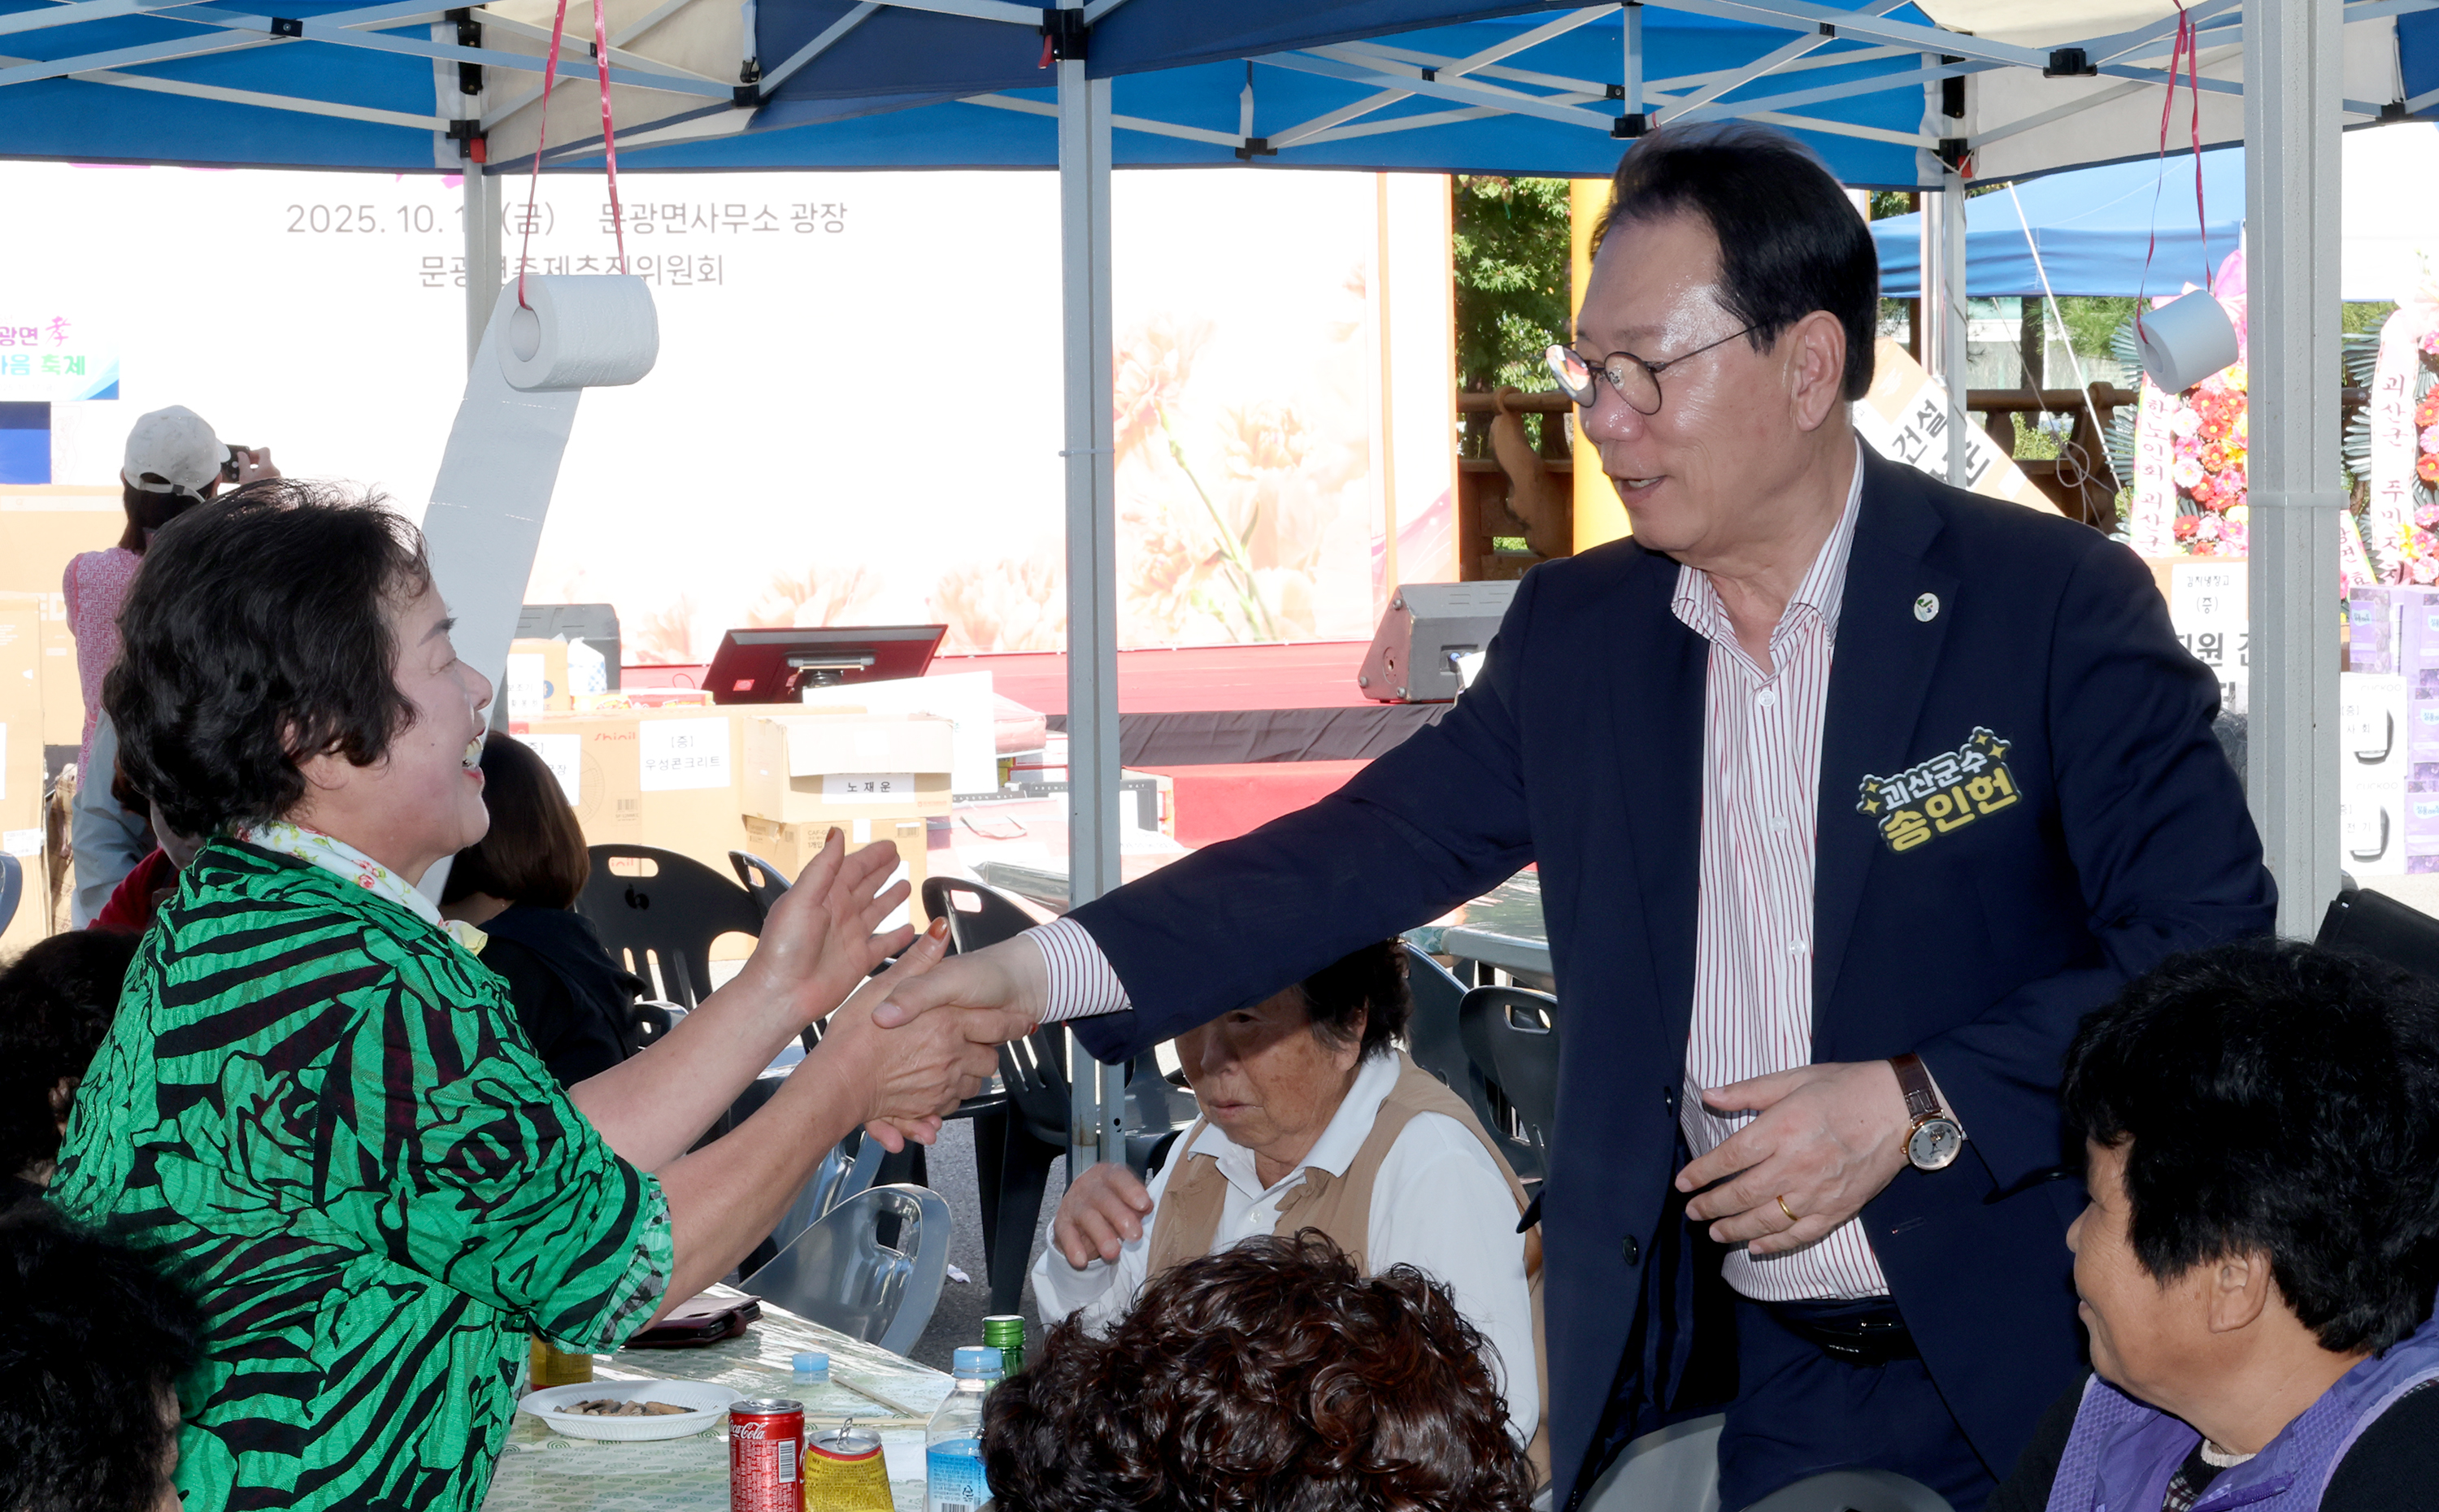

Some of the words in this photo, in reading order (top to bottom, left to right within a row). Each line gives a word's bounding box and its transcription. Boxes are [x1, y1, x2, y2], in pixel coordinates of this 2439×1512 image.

[286, 203, 386, 233] 2025.
[397, 203, 444, 233] 10.
[598, 202, 780, 235] 문광면사무소
[789, 202, 848, 234] 광장
[41, 353, 86, 376] 축제
[2381, 373, 2409, 447] 괴산군
[1891, 398, 1949, 466] 건설
[2186, 575, 2230, 589] 김치냉장고
[2197, 596, 2219, 615] (증)
[645, 755, 721, 771] 우성콘크리트
[1878, 749, 1989, 811] 괴산군수
[1884, 767, 2018, 852] 송인헌
